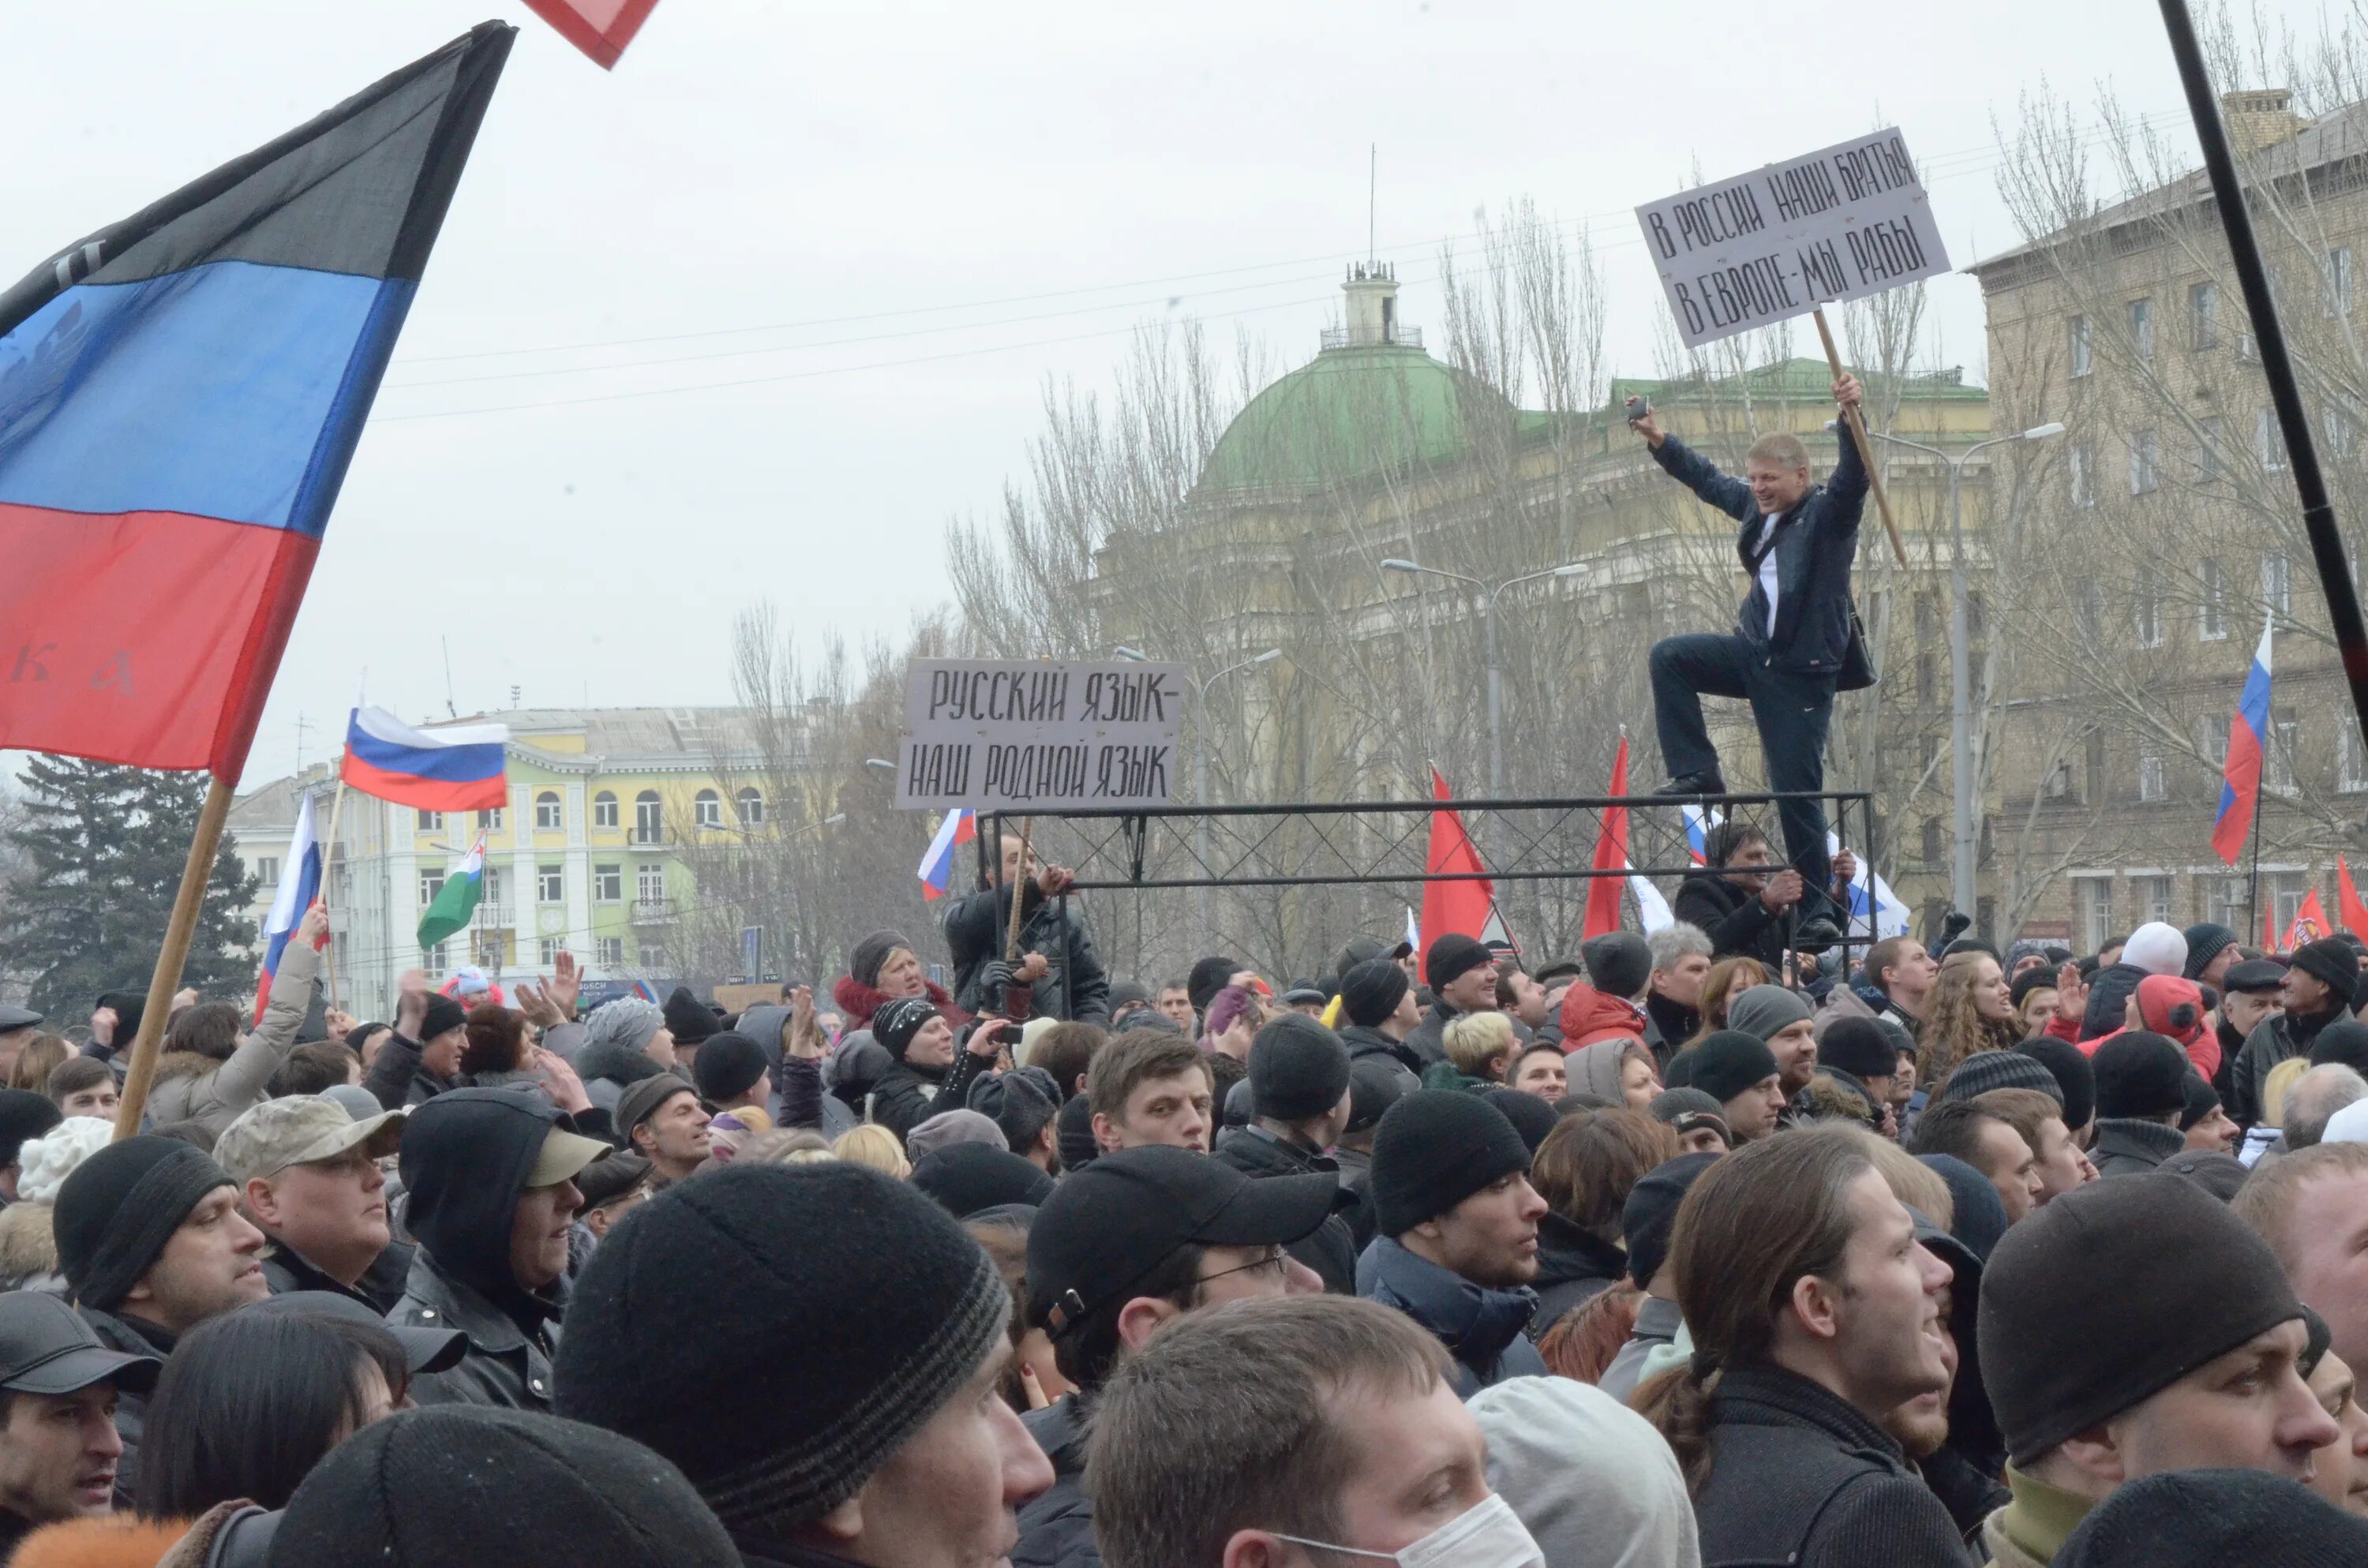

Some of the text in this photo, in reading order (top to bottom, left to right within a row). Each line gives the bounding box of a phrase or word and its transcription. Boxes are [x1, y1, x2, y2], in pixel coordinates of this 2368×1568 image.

[1648, 137, 1916, 260] В РОССИИ НАШИ БРАТЬЯ
[1674, 282, 1704, 335] В
[1845, 215, 1928, 285] РАБЫ
[929, 666, 1069, 721] РУССКИЙ
[909, 739, 1169, 800] НАШ РОДНОЙ ЯЗЫК
